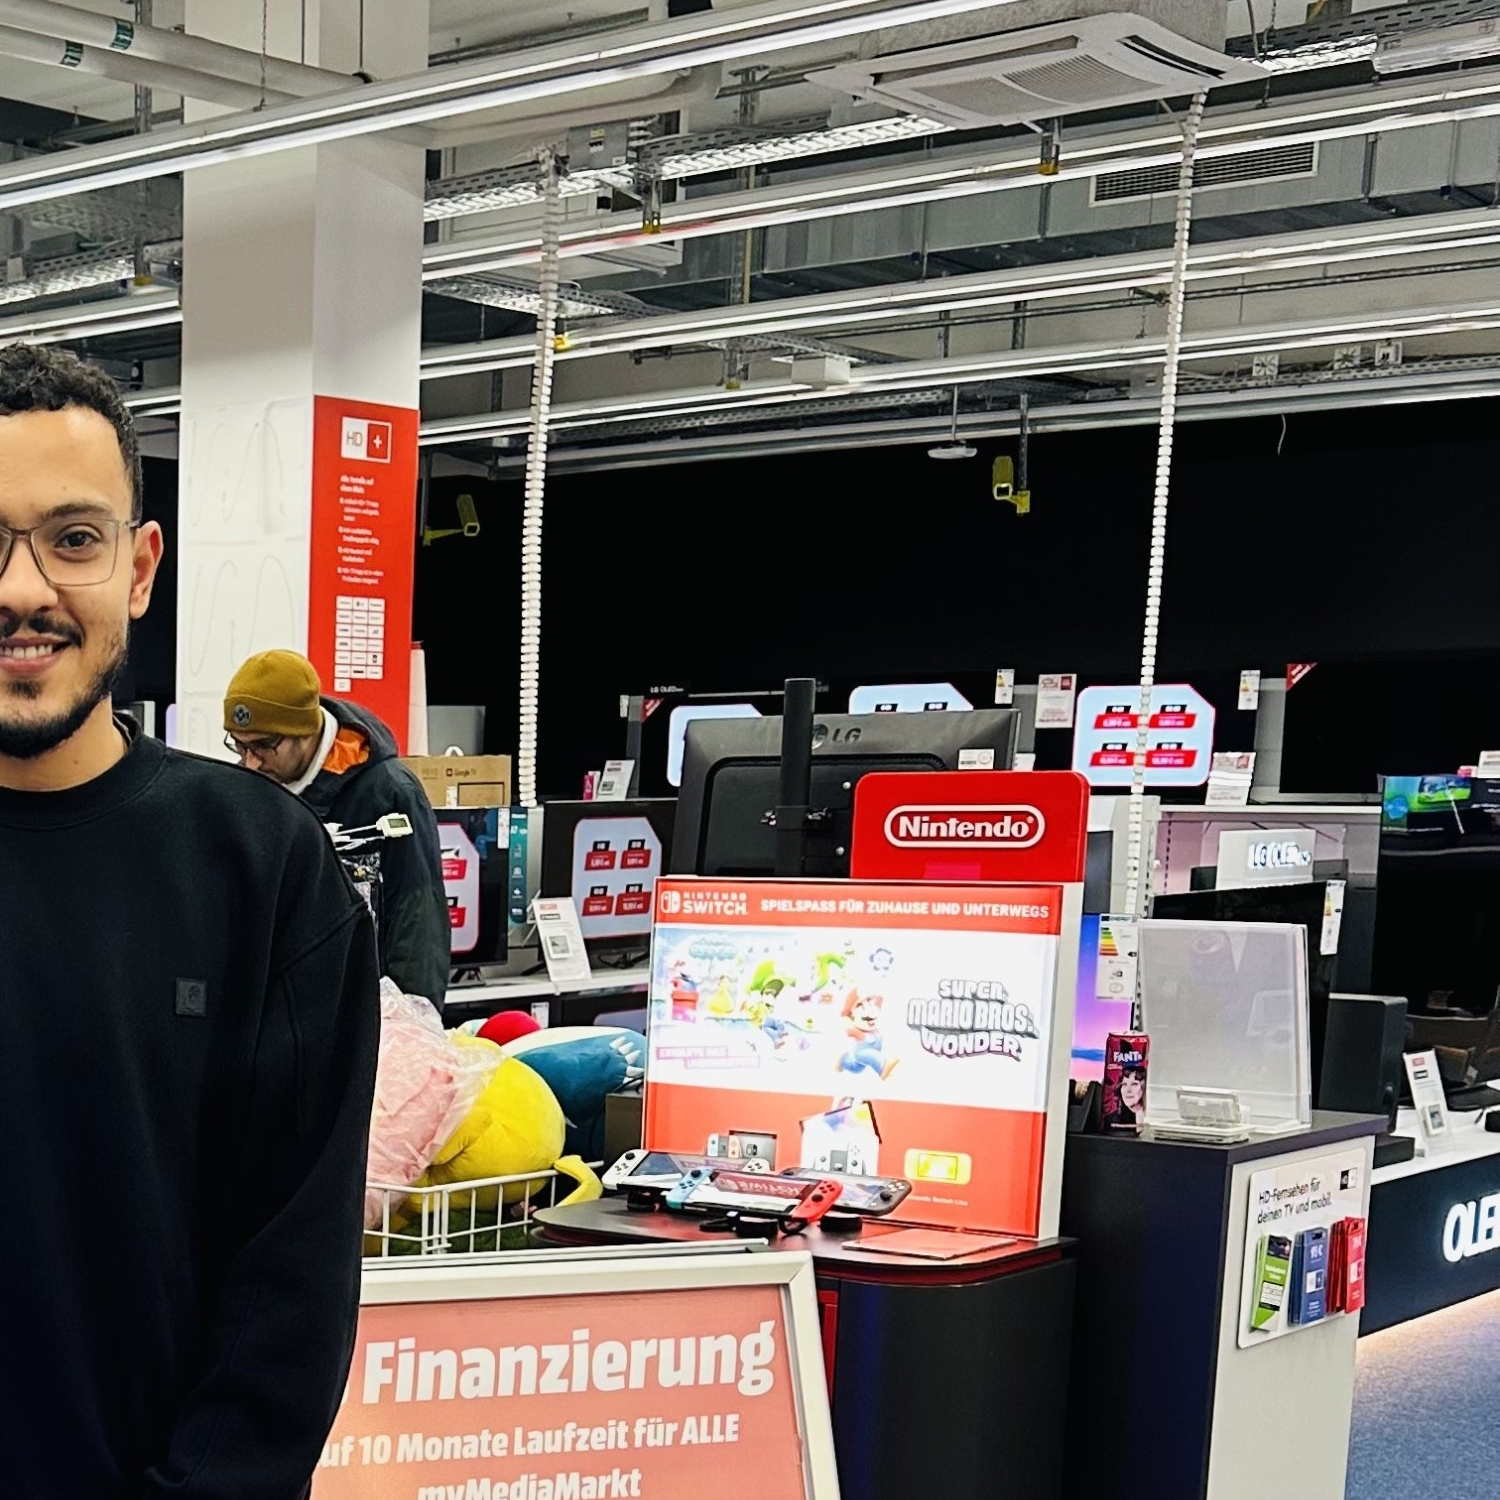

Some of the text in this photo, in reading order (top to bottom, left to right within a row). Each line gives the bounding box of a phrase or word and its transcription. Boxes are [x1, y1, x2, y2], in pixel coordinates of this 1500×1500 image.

[832, 728, 861, 743] LG
[899, 815, 1031, 838] Nintendo
[683, 891, 747, 901] NINTENDO
[683, 901, 747, 916] SWITCH
[760, 898, 1050, 919] SPIELSPASS FÜR ZUHAUSE UND UNTERWEGS
[938, 979, 1006, 1001] SUPER
[907, 998, 973, 1029] MARIO
[921, 1026, 1020, 1057] WONDER
[1258, 1181, 1309, 1205] HD-Fernsehen
[1257, 1207, 1283, 1224] deinen
[1284, 1203, 1294, 1218] TV
[1295, 1199, 1310, 1215] und
[363, 1320, 776, 1404] Finanzierung
[320, 1414, 740, 1468] uf 10 Monate Laufzeit für ALLE
